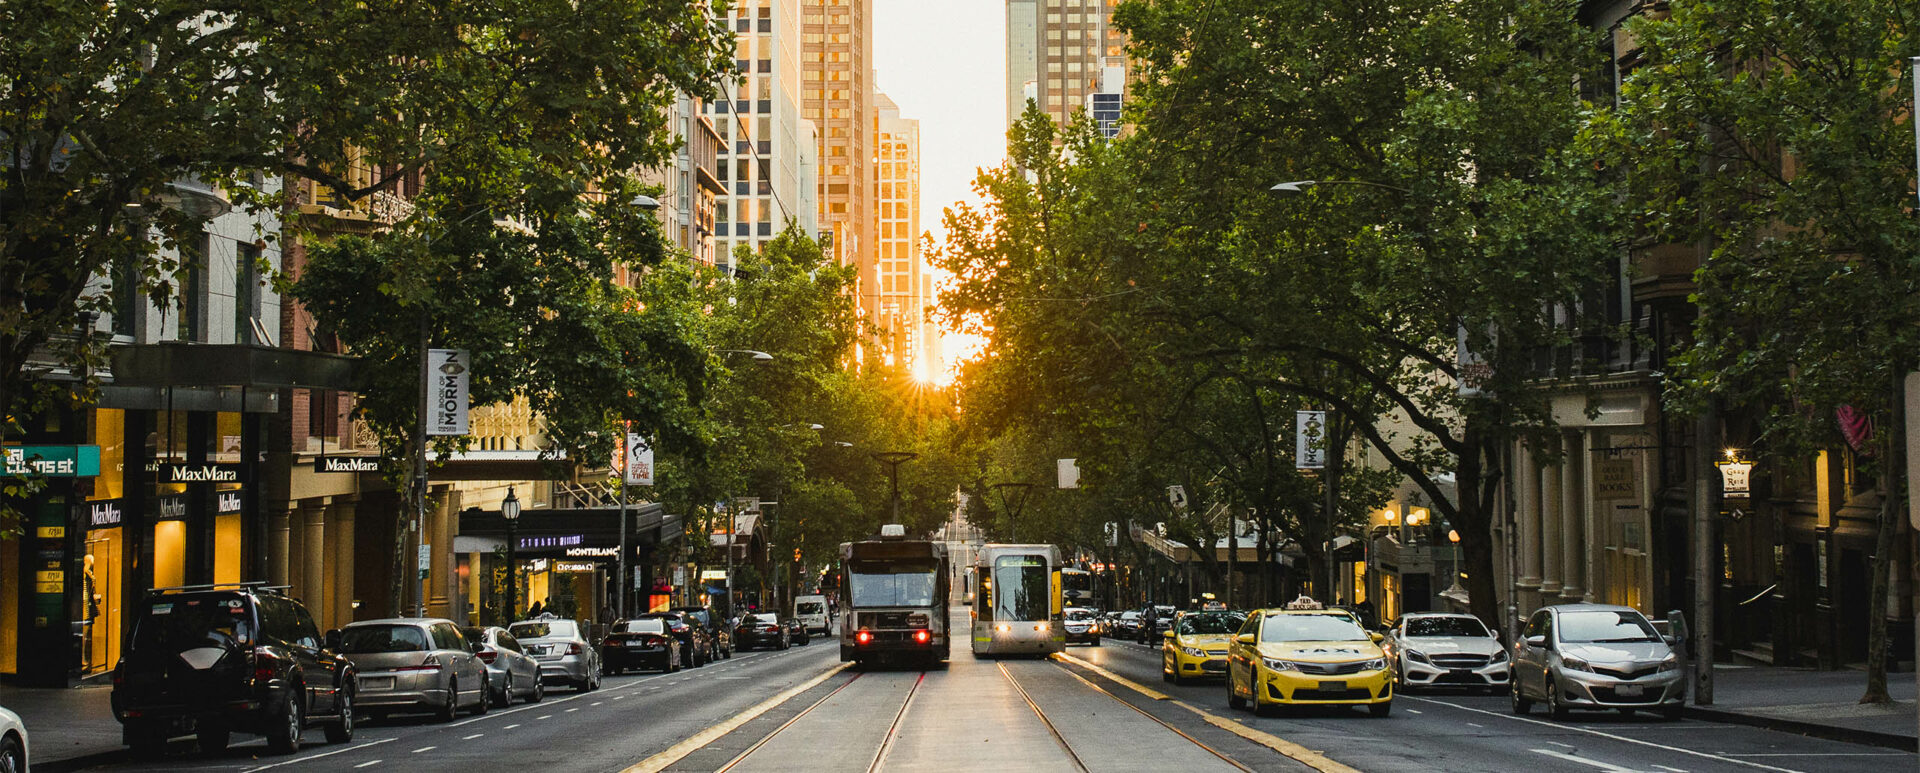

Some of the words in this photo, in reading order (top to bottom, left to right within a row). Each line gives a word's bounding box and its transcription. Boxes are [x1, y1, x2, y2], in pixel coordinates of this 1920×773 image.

[57, 458, 74, 473] st
[324, 458, 378, 471] MaxMara
[171, 465, 237, 481] MaxMara
[631, 472, 649, 480] TIME
[159, 498, 186, 518] MaxMara
[218, 493, 241, 513] MaxMara
[91, 503, 121, 526] MaxMara
[566, 547, 618, 556] MONTBLANC
